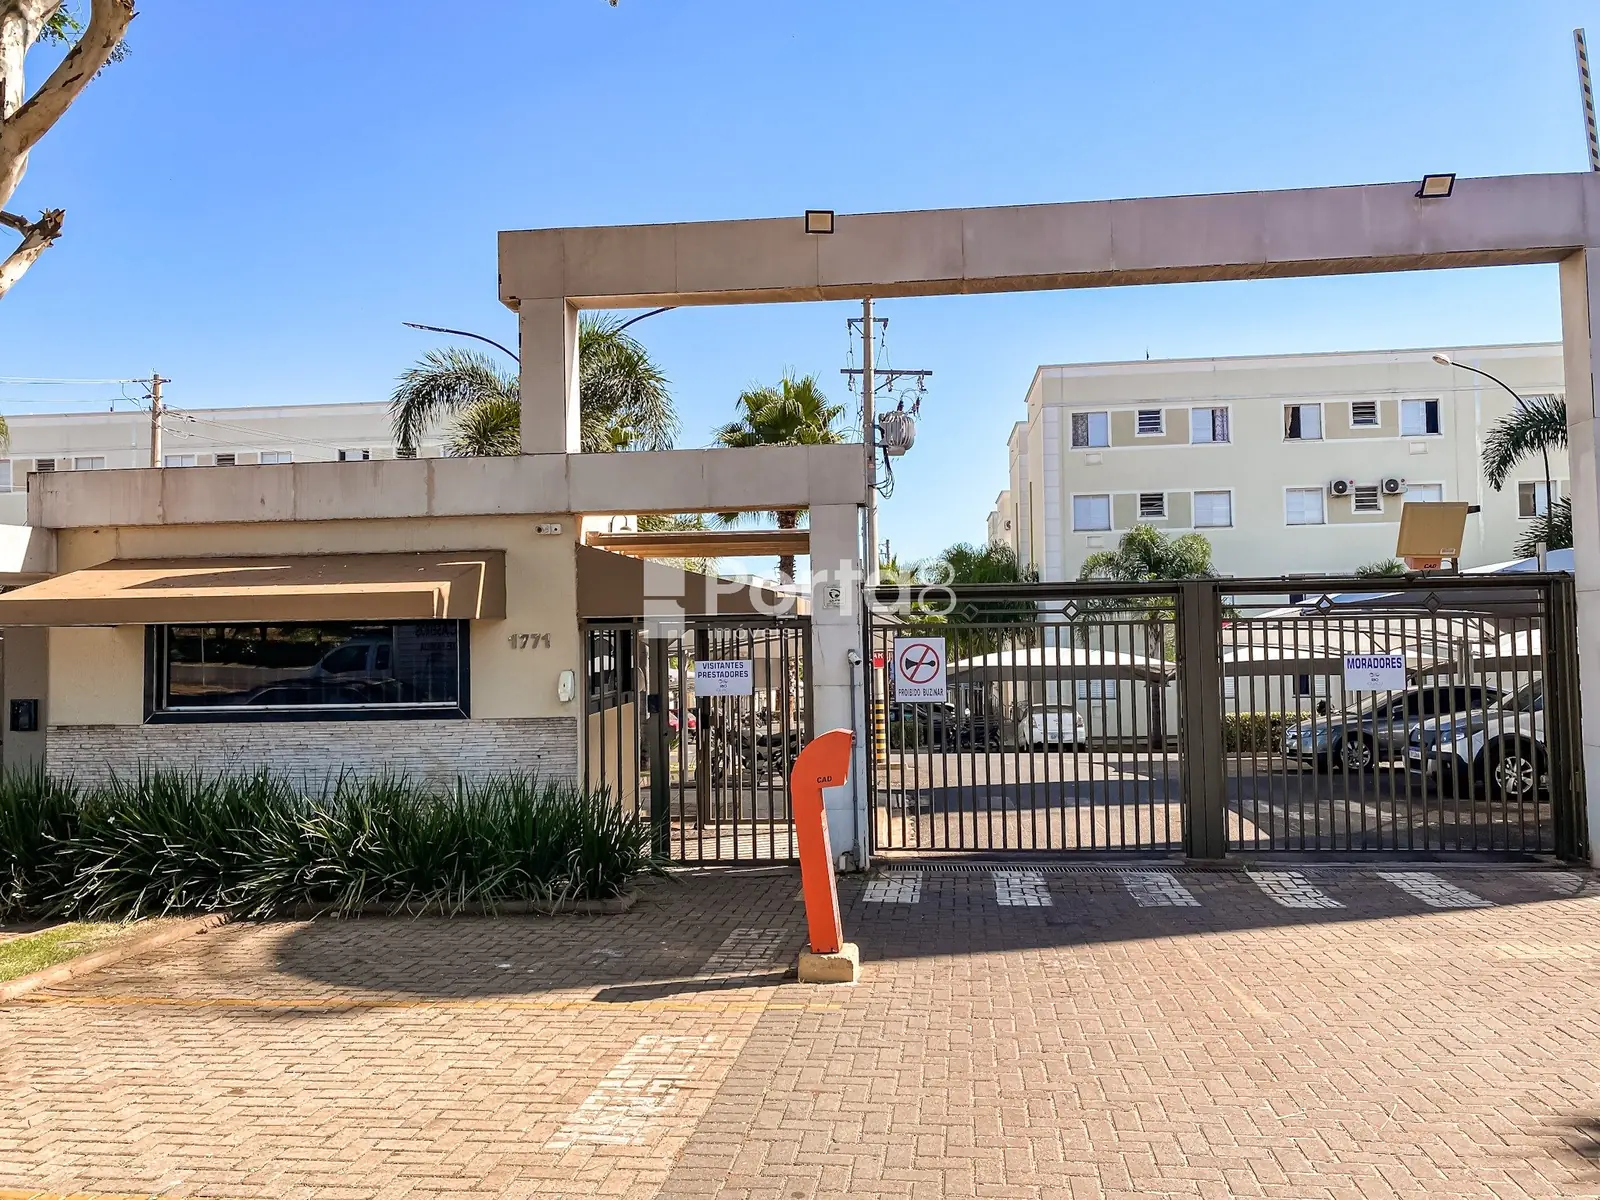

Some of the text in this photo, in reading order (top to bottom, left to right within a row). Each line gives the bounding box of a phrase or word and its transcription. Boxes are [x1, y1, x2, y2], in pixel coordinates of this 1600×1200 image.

[508, 632, 551, 650] 1771
[702, 661, 744, 670] VISITANTES
[1346, 657, 1402, 670] MORADORES
[697, 670, 749, 679] PRESTADORES
[898, 688, 944, 697] PROIBIDO BUZINAR
[816, 775, 832, 784] CAD
